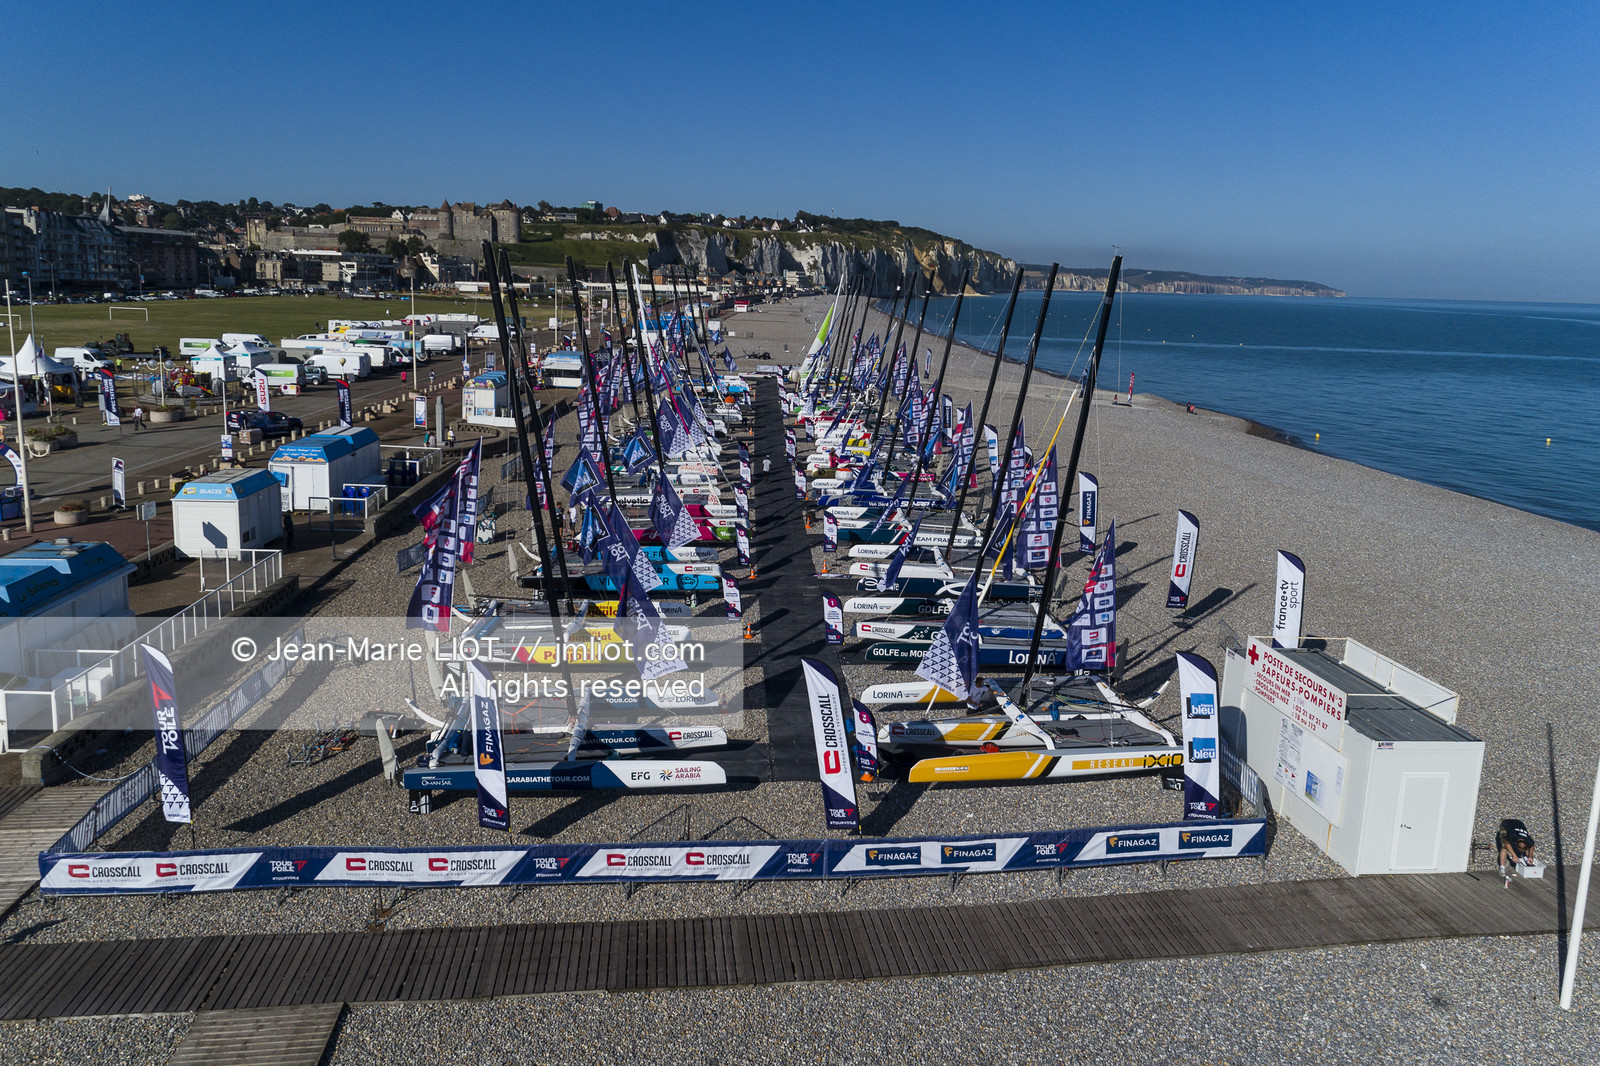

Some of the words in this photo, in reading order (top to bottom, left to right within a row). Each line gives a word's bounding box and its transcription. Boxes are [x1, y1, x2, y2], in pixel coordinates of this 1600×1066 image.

[258, 378, 266, 404] ISUZU
[1179, 532, 1191, 562] CROSSCALL
[1290, 581, 1300, 608] sport
[854, 602, 878, 610] LORINA
[873, 648, 899, 656] GOLFE
[1263, 651, 1283, 670] POSTE
[1284, 665, 1293, 676] DE
[1294, 671, 1327, 697] SECOURS
[1257, 672, 1274, 688] SECOURS
[1275, 684, 1280, 692] EN
[1281, 688, 1290, 698] MER
[873, 690, 902, 698] LORINA
[1255, 686, 1275, 704] POMPIERS
[1262, 664, 1341, 720] SAPEURS-POMPIERS
[1192, 705, 1214, 715] bleu
[818, 693, 837, 748] CROSSCALL
[157, 710, 167, 754] TOUR
[165, 707, 179, 750] VOILE
[481, 701, 494, 753] FINAGAZ
[906, 725, 935, 735] CROSSCALL
[682, 730, 713, 739] CROSSCALL
[1194, 749, 1215, 759] bleu
[1090, 758, 1134, 770] RÉSEAU
[631, 771, 650, 780] EFG
[675, 766, 701, 774] SAILING
[1118, 838, 1157, 847] FINAGAZ
[1191, 835, 1229, 843] FINAGAZ
[878, 852, 918, 861] FINAGAZ
[954, 849, 993, 857] FINAGAZ
[450, 858, 496, 871] CROSSCALL
[628, 855, 672, 866] CROSSCALL
[707, 854, 750, 865] CROSSCALL
[180, 862, 230, 875] CROSSCALL
[369, 860, 414, 871] CROSSCALL
[92, 866, 142, 878] CROSSCALL
